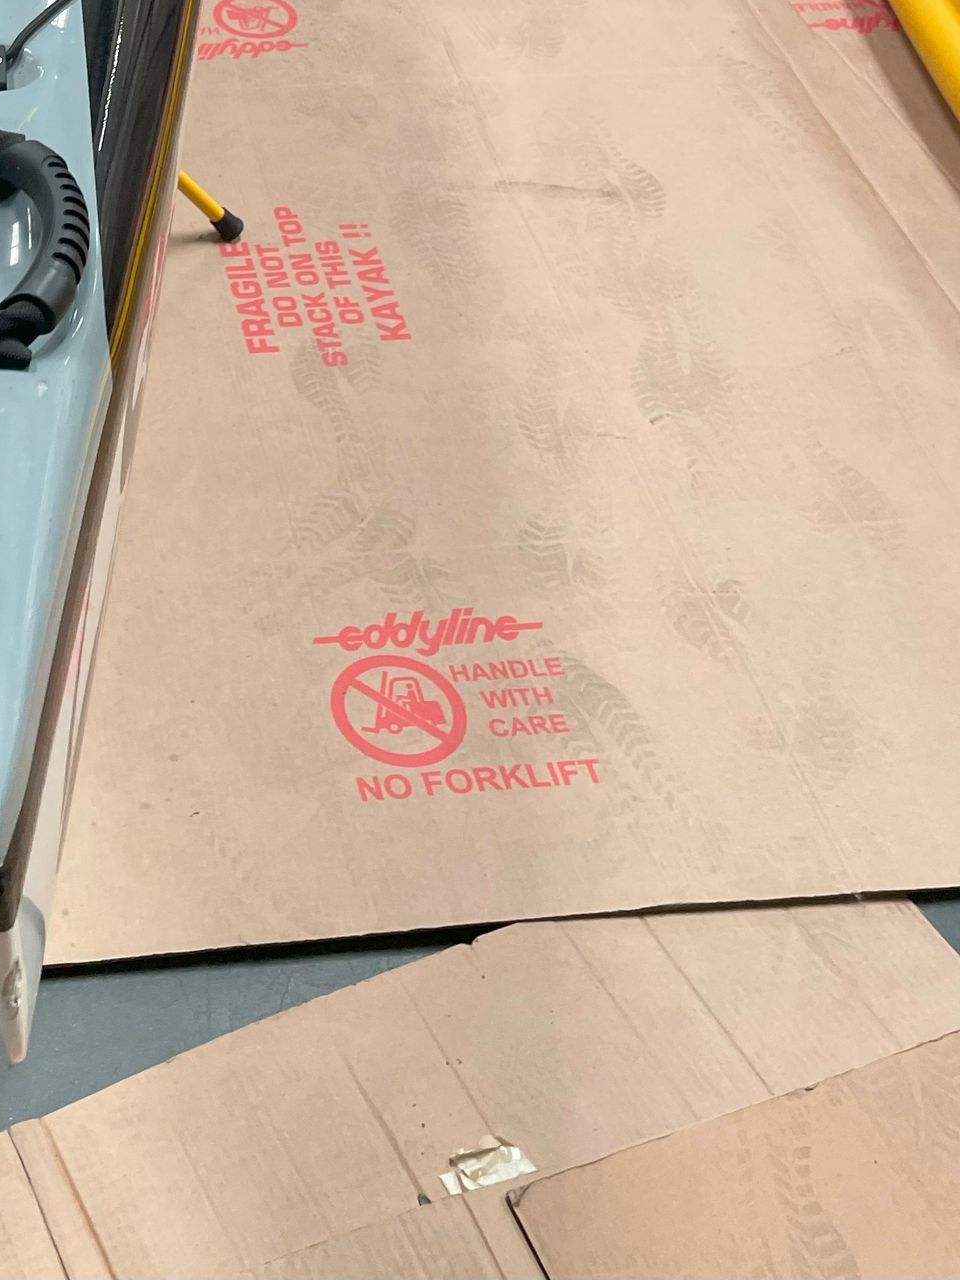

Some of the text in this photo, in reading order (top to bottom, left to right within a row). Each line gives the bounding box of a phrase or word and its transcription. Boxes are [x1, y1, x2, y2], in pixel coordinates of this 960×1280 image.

[219, 241, 280, 354] FRAGILE
[256, 244, 303, 327] DO NOT
[273, 206, 349, 367] STACK ON TOP
[314, 240, 365, 325] OF THIS
[348, 247, 412, 341] KAYAK
[312, 607, 544, 657] eddyline
[448, 656, 566, 683] HANDLE
[479, 686, 556, 709] WITH
[489, 713, 571, 738] CARE
[355, 758, 601, 802] NO FORKLIFT
